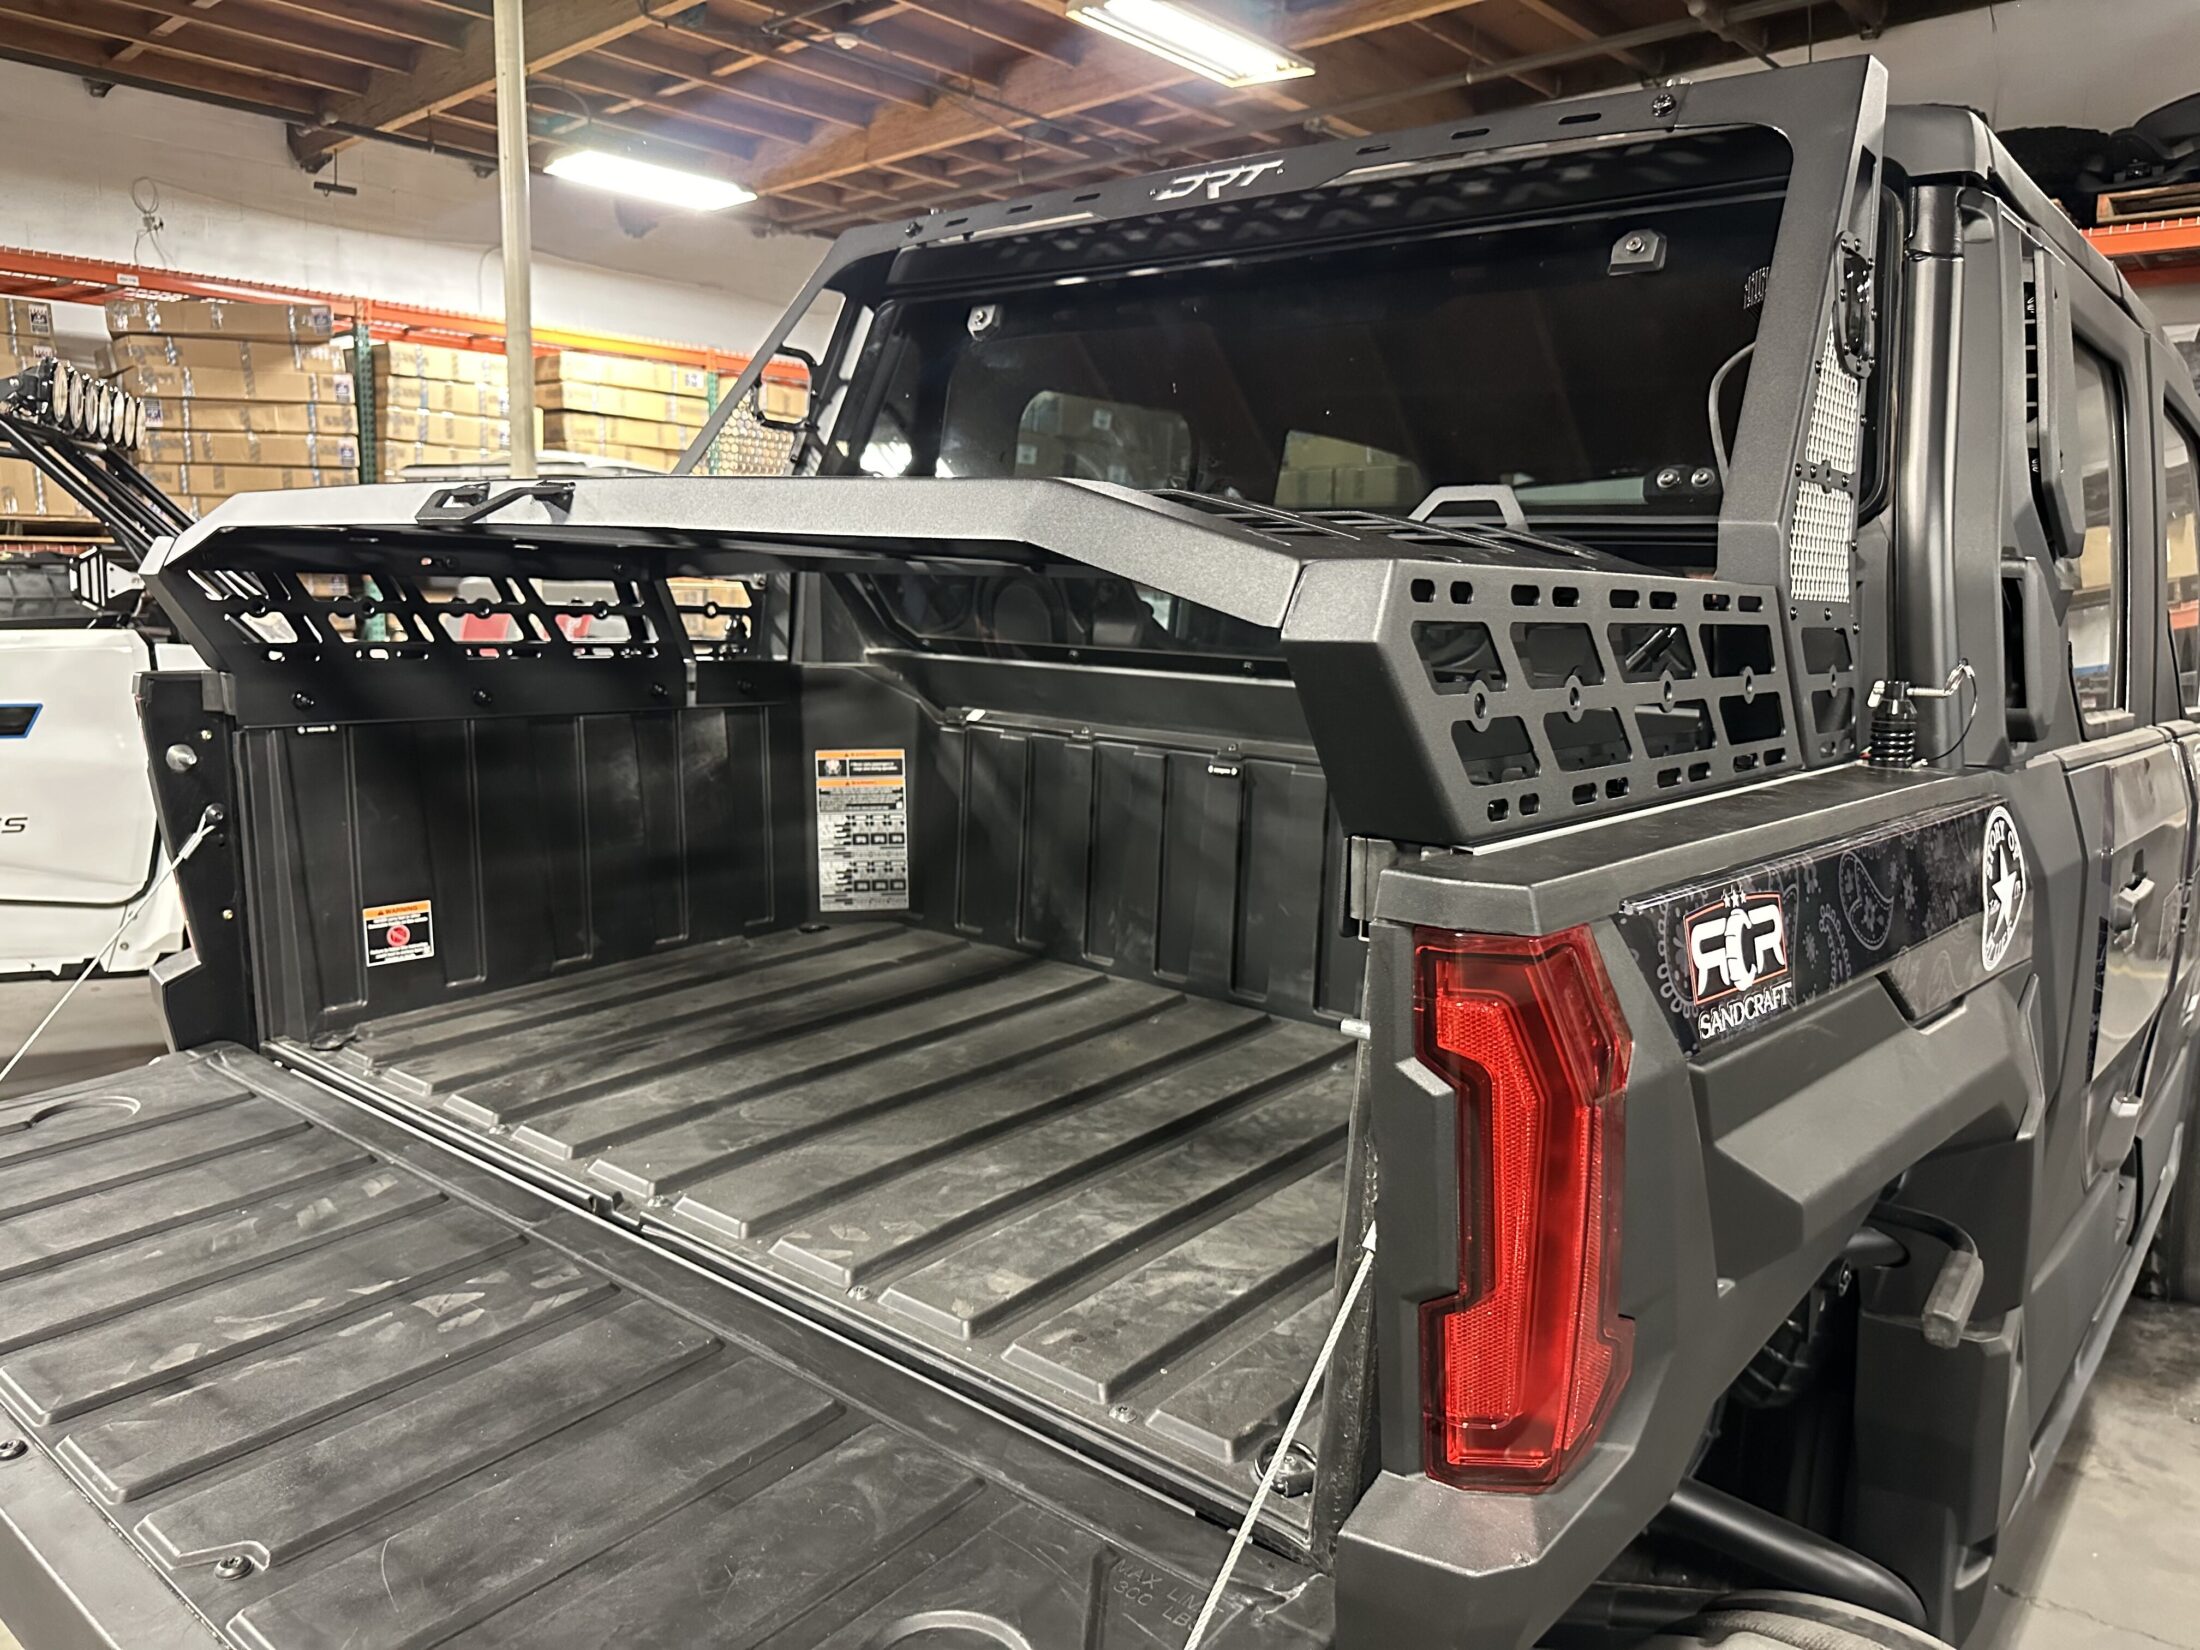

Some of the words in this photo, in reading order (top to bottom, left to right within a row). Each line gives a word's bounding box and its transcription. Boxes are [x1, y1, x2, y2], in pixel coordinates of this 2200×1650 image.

[0, 817, 28, 833] S
[1699, 982, 1792, 1040] SANDCRAFT
[1113, 1558, 1163, 1589] MAX
[1113, 1580, 1153, 1606] 300
